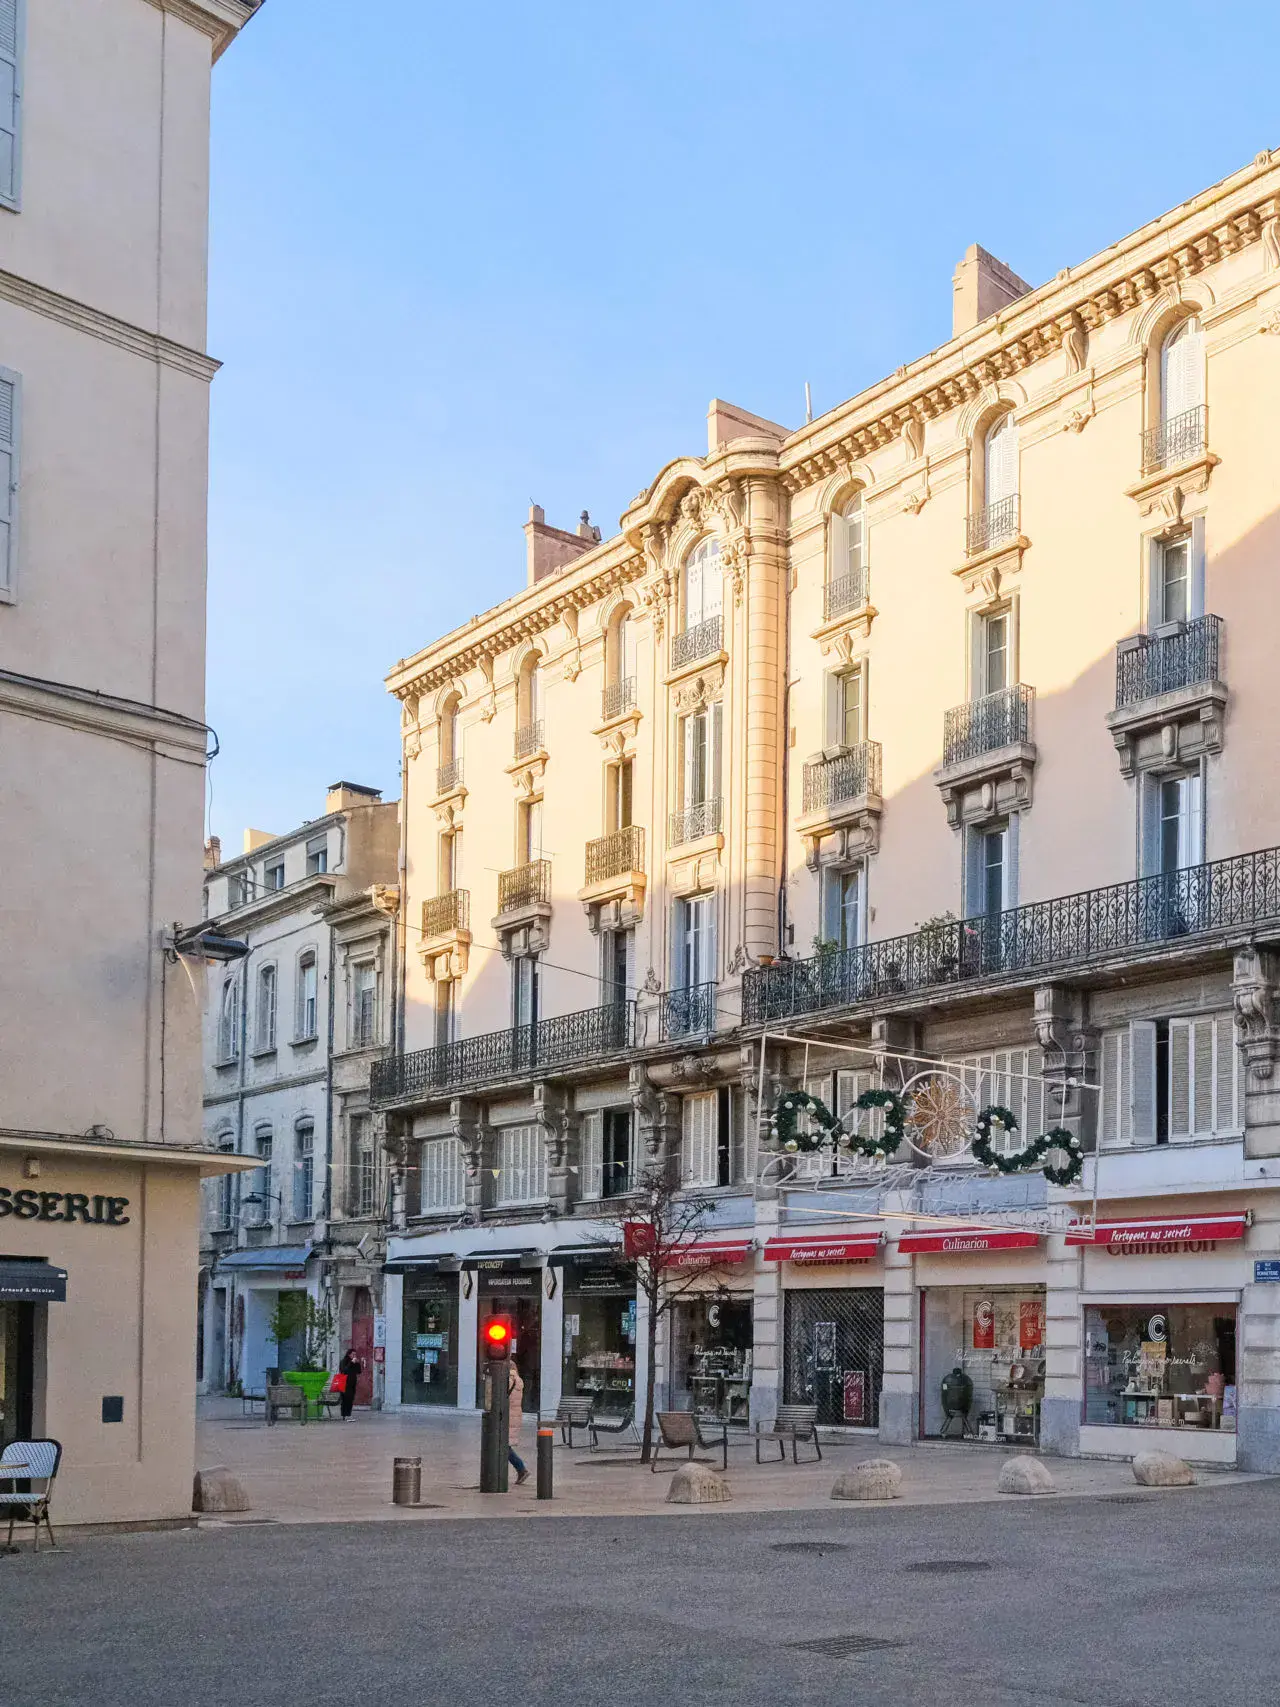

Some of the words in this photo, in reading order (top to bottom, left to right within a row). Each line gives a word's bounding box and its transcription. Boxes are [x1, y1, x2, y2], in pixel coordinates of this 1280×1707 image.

[1150, 1231, 1161, 1240] nos
[1163, 1225, 1192, 1239] secrets
[943, 1236, 989, 1250] Culinarion
